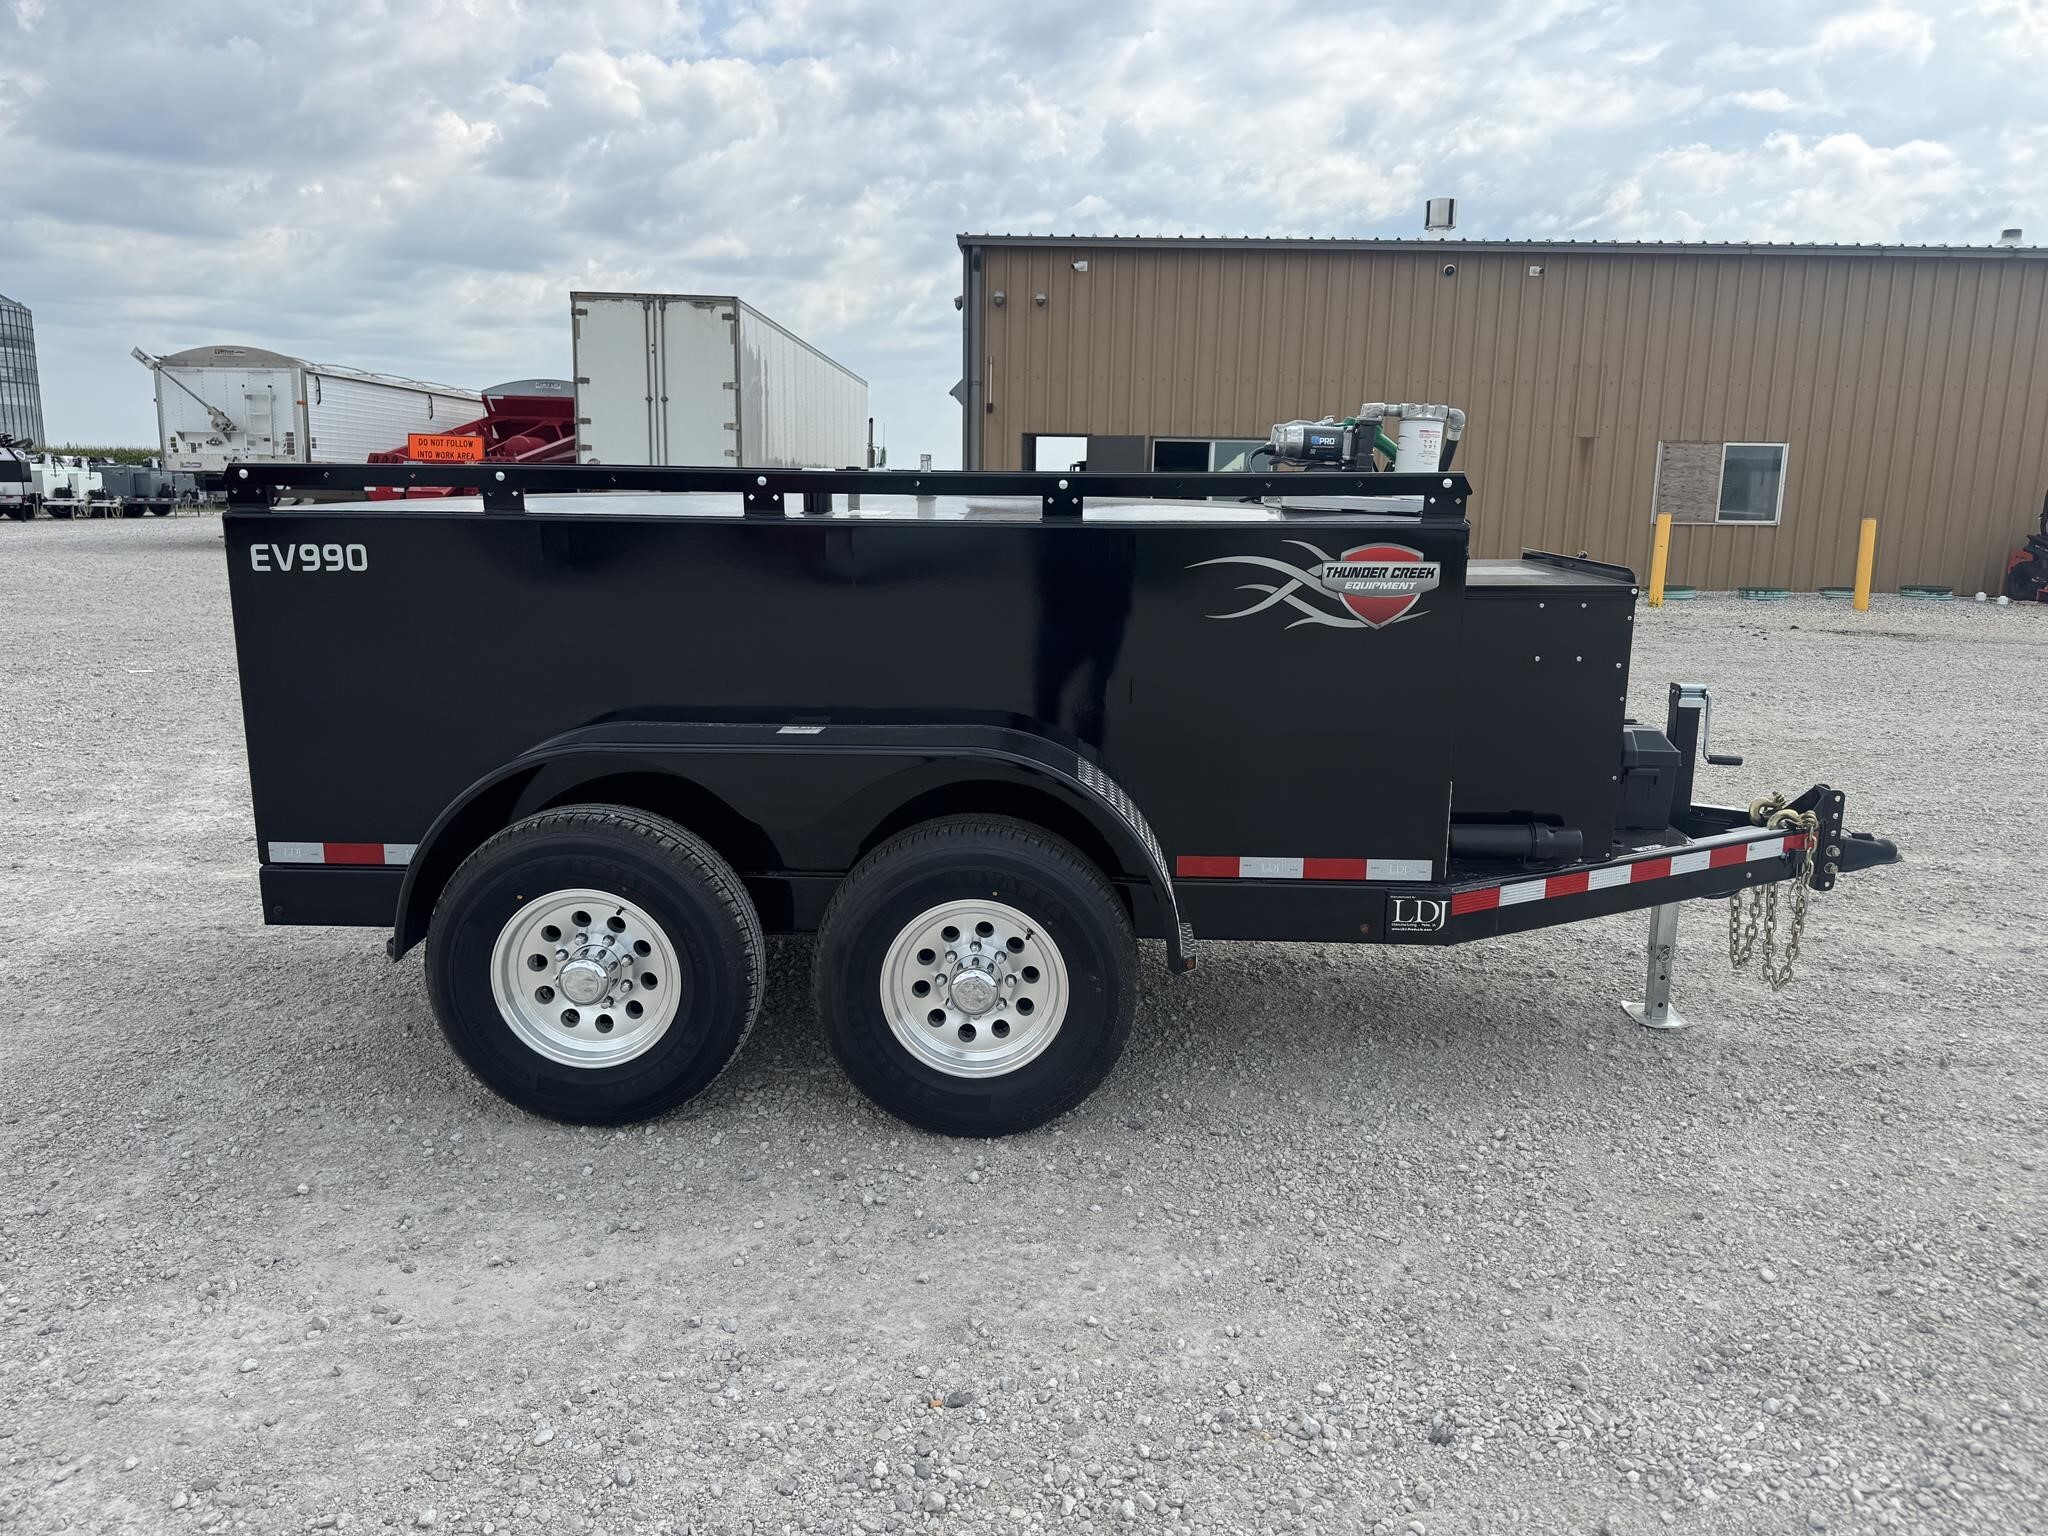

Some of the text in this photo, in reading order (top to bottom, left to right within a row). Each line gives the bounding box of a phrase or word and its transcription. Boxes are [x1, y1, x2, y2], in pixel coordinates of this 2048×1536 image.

[418, 438, 428, 446] DO
[446, 440, 473, 448] FOLLOW
[417, 450, 475, 460] INTO WORK AREA
[250, 543, 368, 572] EV990
[1326, 567, 1437, 579] THUNDER CREEK
[1344, 581, 1417, 590] EQUIPMENT
[1391, 899, 1451, 931] LDJ
